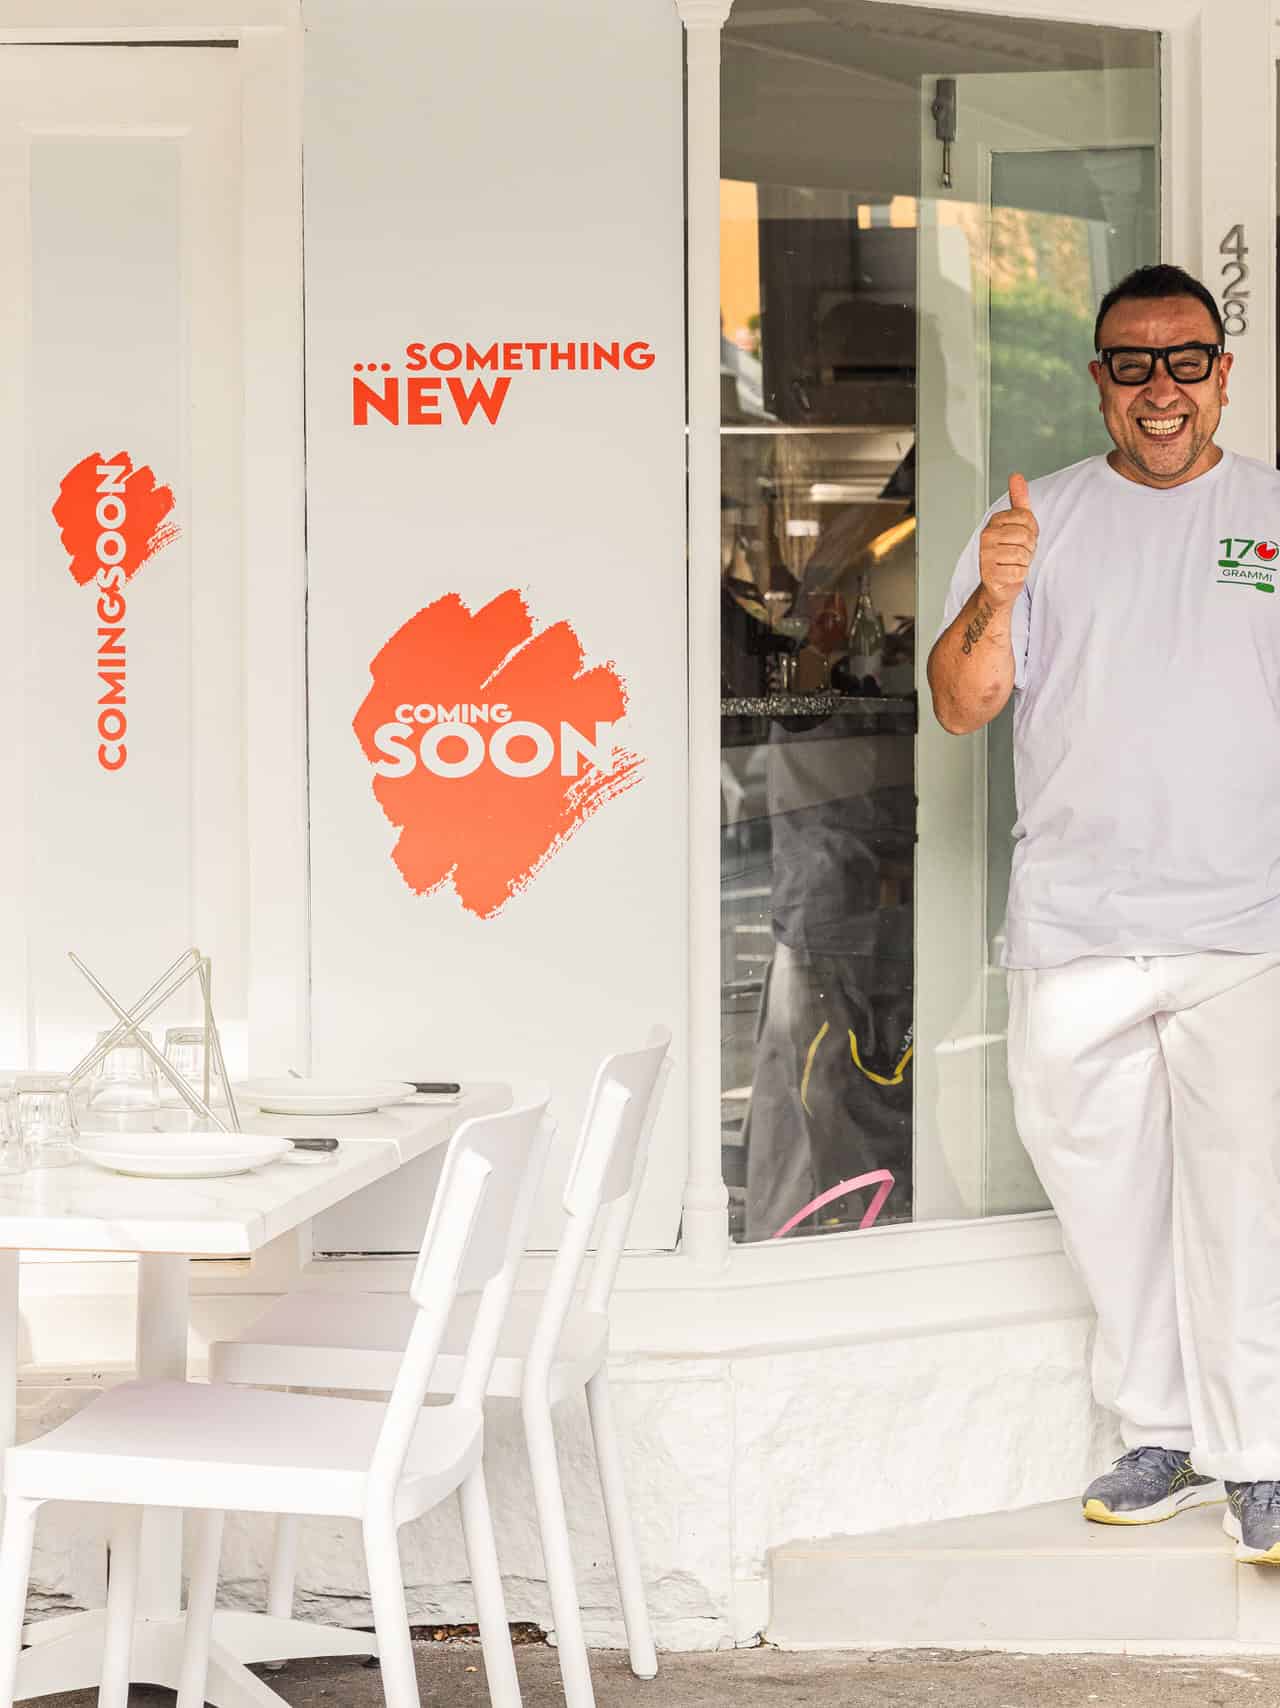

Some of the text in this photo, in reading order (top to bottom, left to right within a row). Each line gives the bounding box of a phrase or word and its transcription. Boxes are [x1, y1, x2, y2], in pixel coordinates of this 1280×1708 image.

[1219, 223, 1251, 337] 428
[405, 341, 656, 372] SOMETHING
[353, 377, 512, 426] NEW
[1222, 568, 1273, 583] GRAMMI
[96, 465, 127, 771] COMING SOON
[394, 703, 513, 724] COMING
[373, 720, 615, 779] SOON
